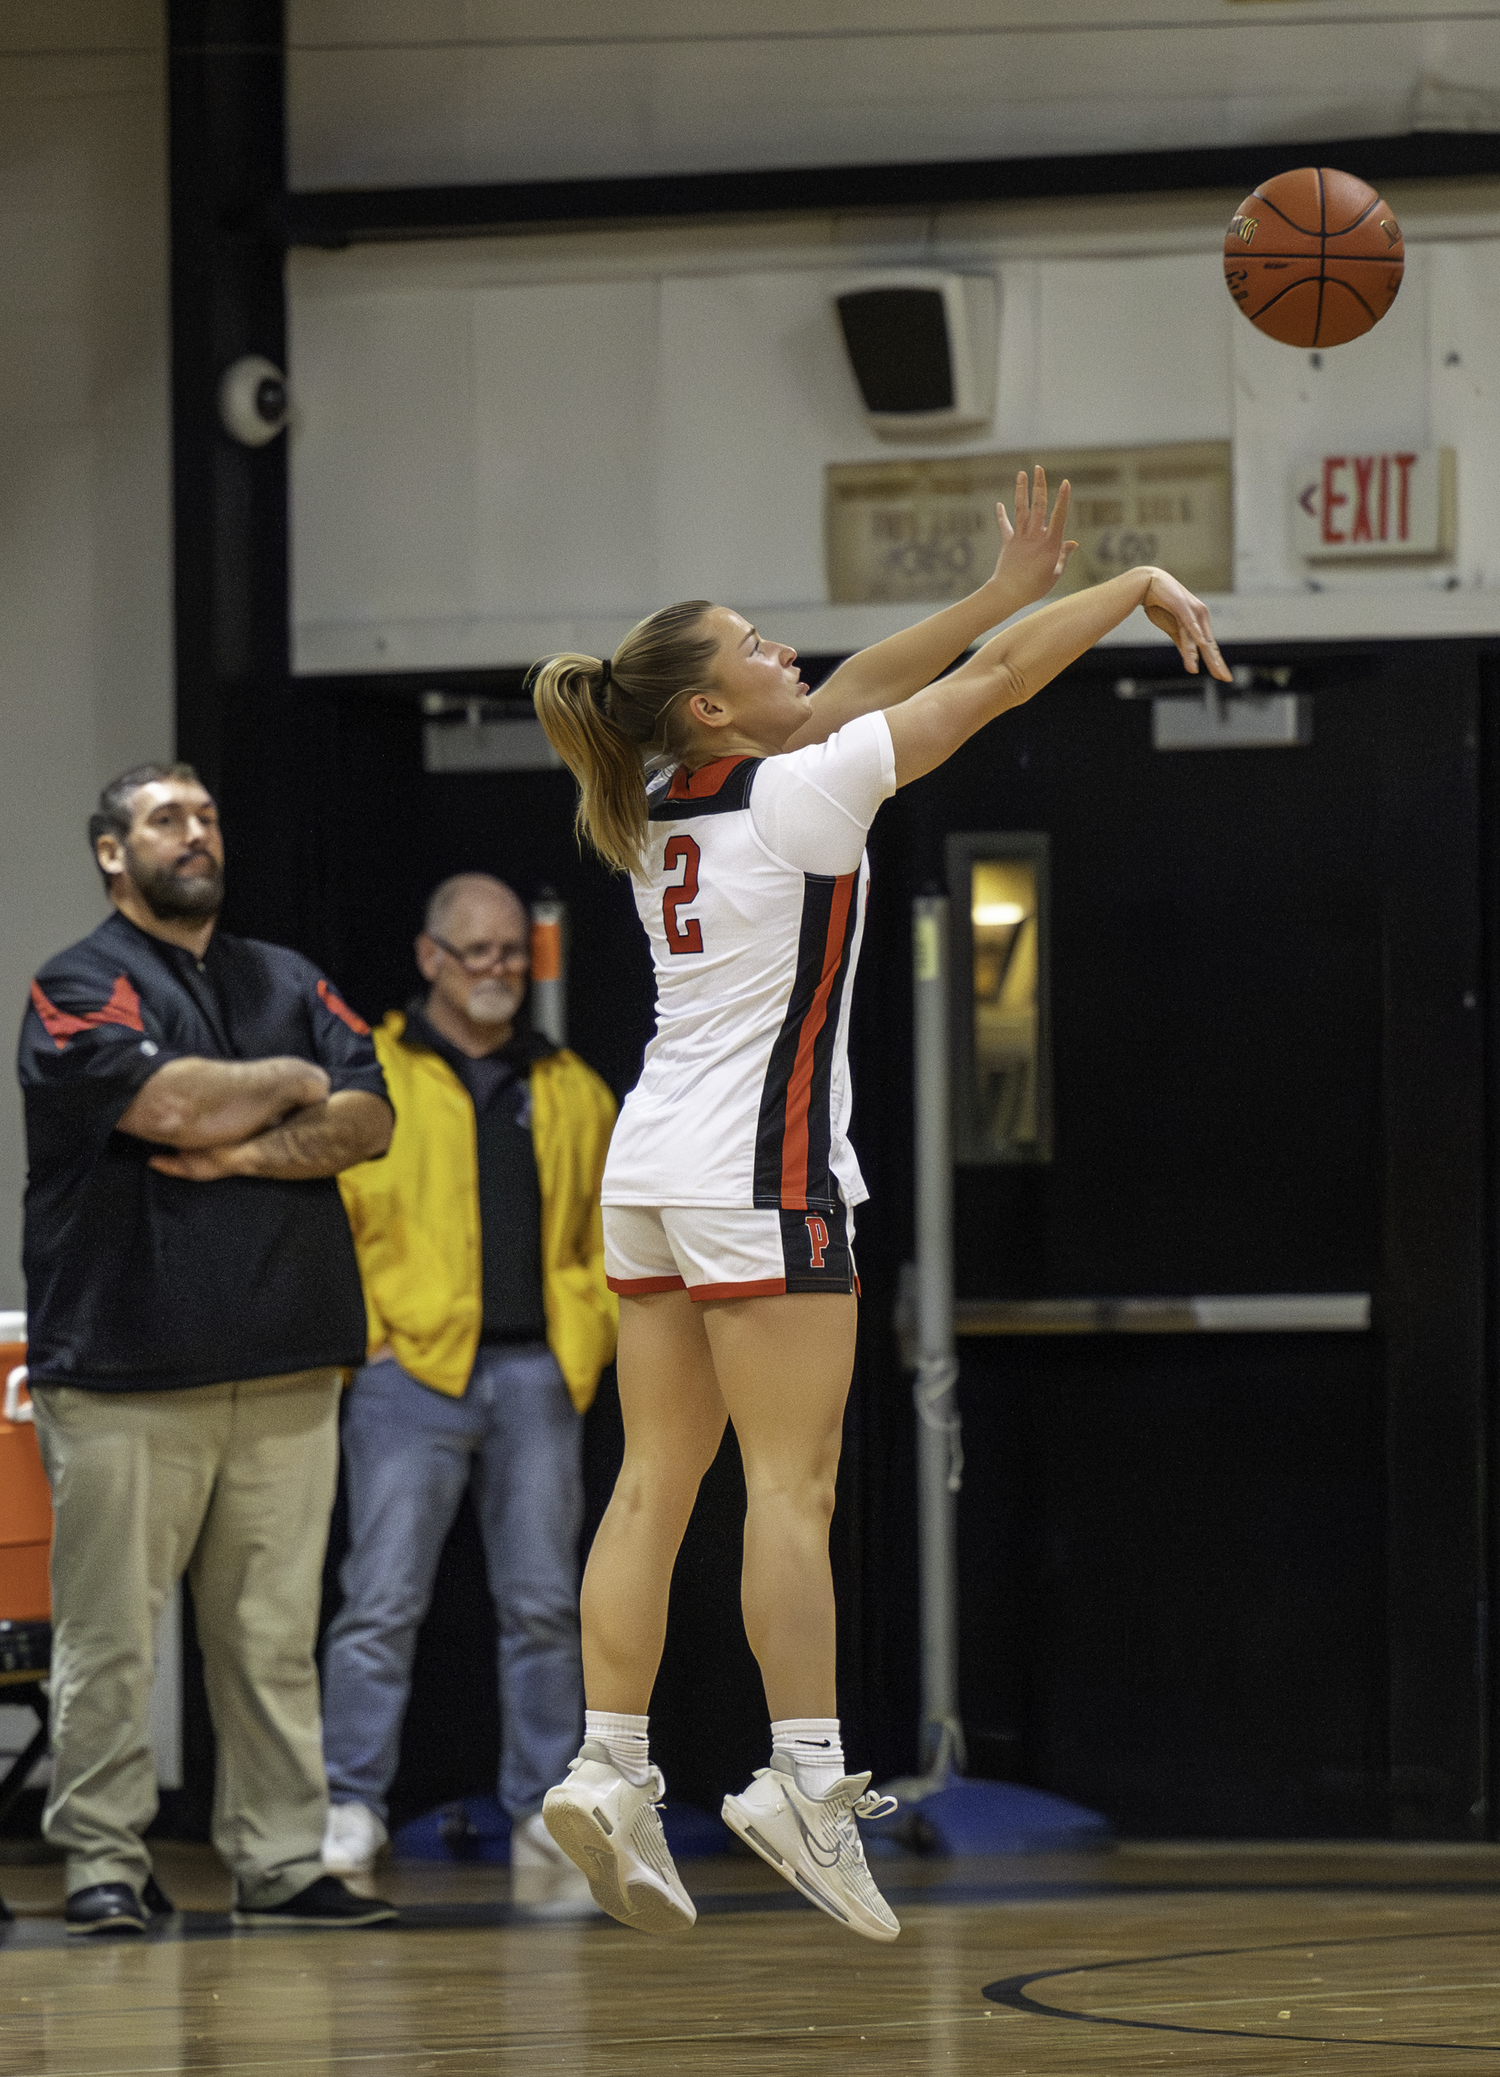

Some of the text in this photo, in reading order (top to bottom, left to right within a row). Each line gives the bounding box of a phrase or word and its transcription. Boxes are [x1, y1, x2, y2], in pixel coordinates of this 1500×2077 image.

[1321, 453, 1418, 545] EXIT
[662, 834, 704, 955] 2
[805, 1216, 830, 1269] P
